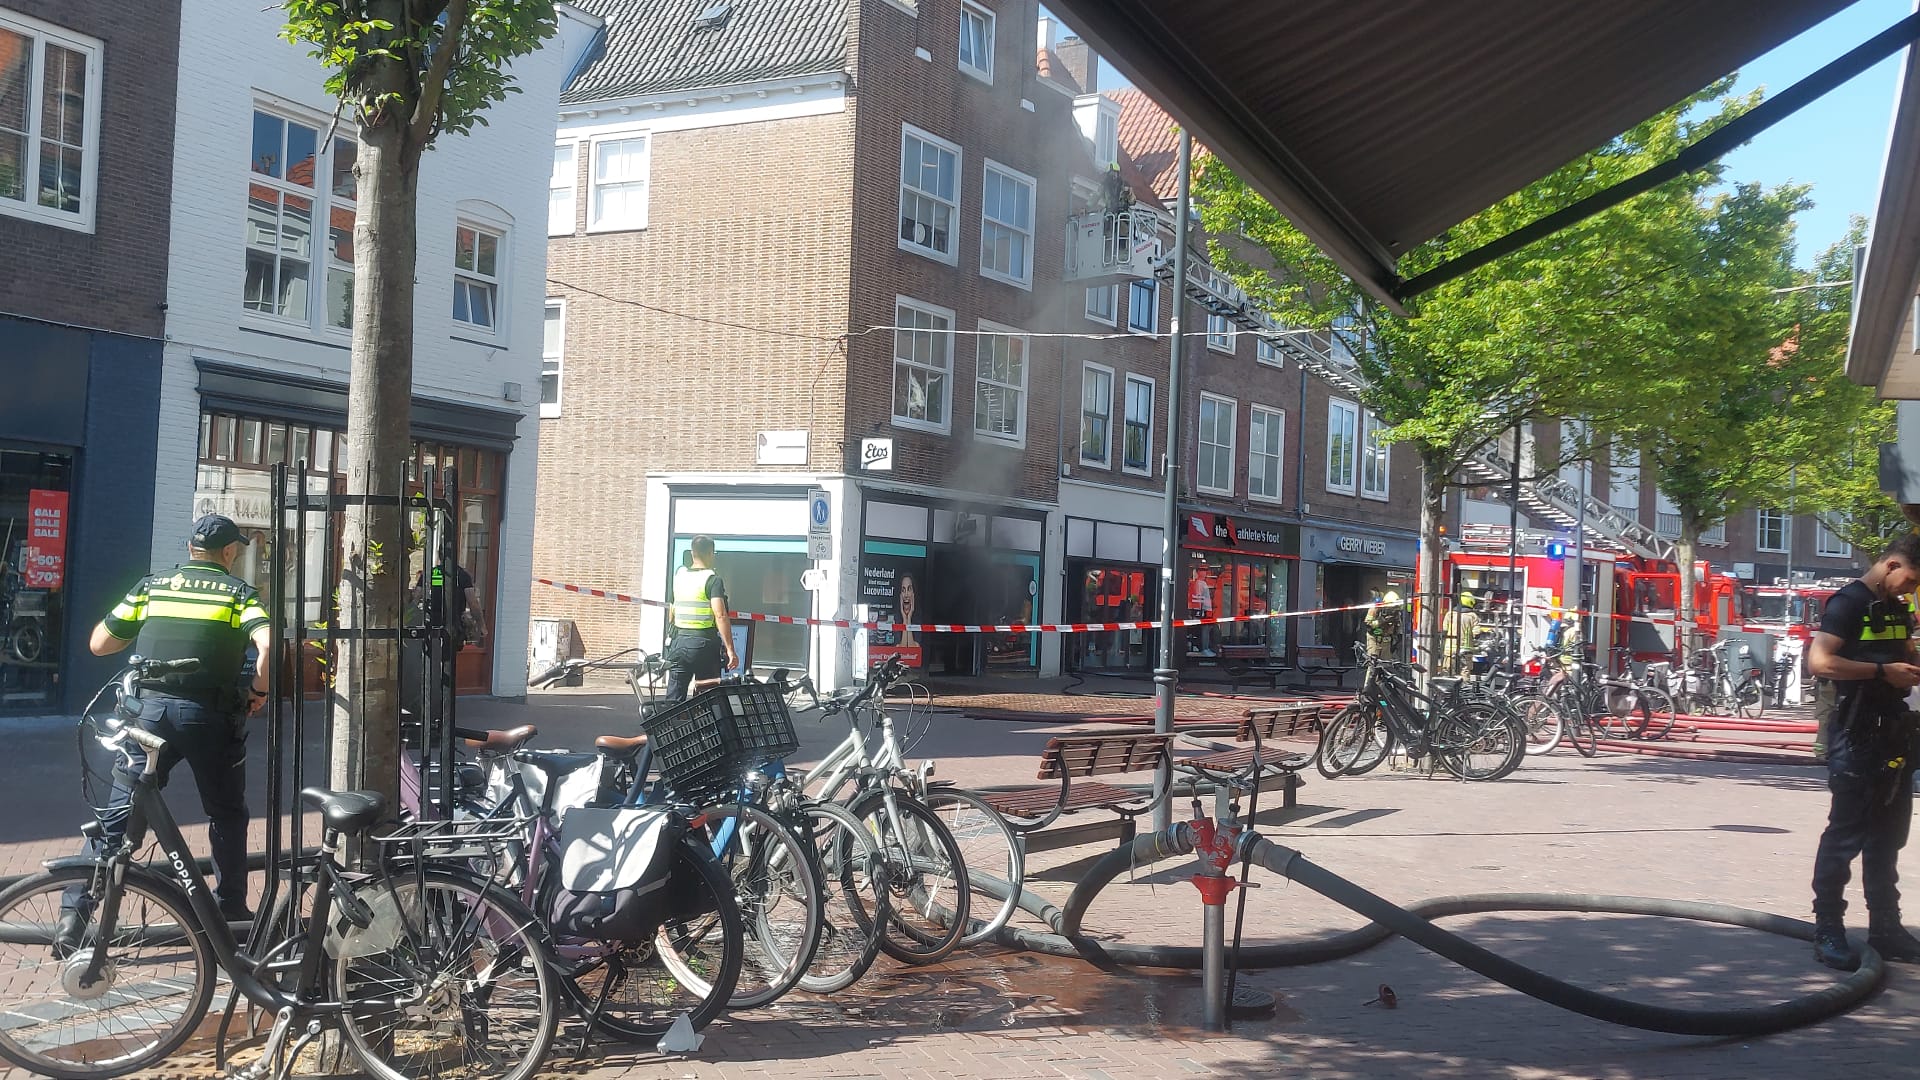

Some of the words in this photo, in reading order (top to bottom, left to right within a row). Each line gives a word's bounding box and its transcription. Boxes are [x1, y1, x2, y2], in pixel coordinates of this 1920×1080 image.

[865, 443, 888, 460] Etos
[34, 508, 61, 518] SALE
[34, 518, 60, 528] SALE
[34, 528, 60, 538] SALE
[1215, 524, 1228, 537] the
[1237, 528, 1266, 542] athlete's
[1266, 531, 1280, 544] foot
[1340, 536, 1362, 552] GERRY
[1363, 539, 1386, 555] WEBER
[864, 567, 895, 579] Nederland
[161, 573, 227, 592] POLITIE
[863, 585, 894, 597] Lucovitaal
[169, 851, 197, 896] POPAL
